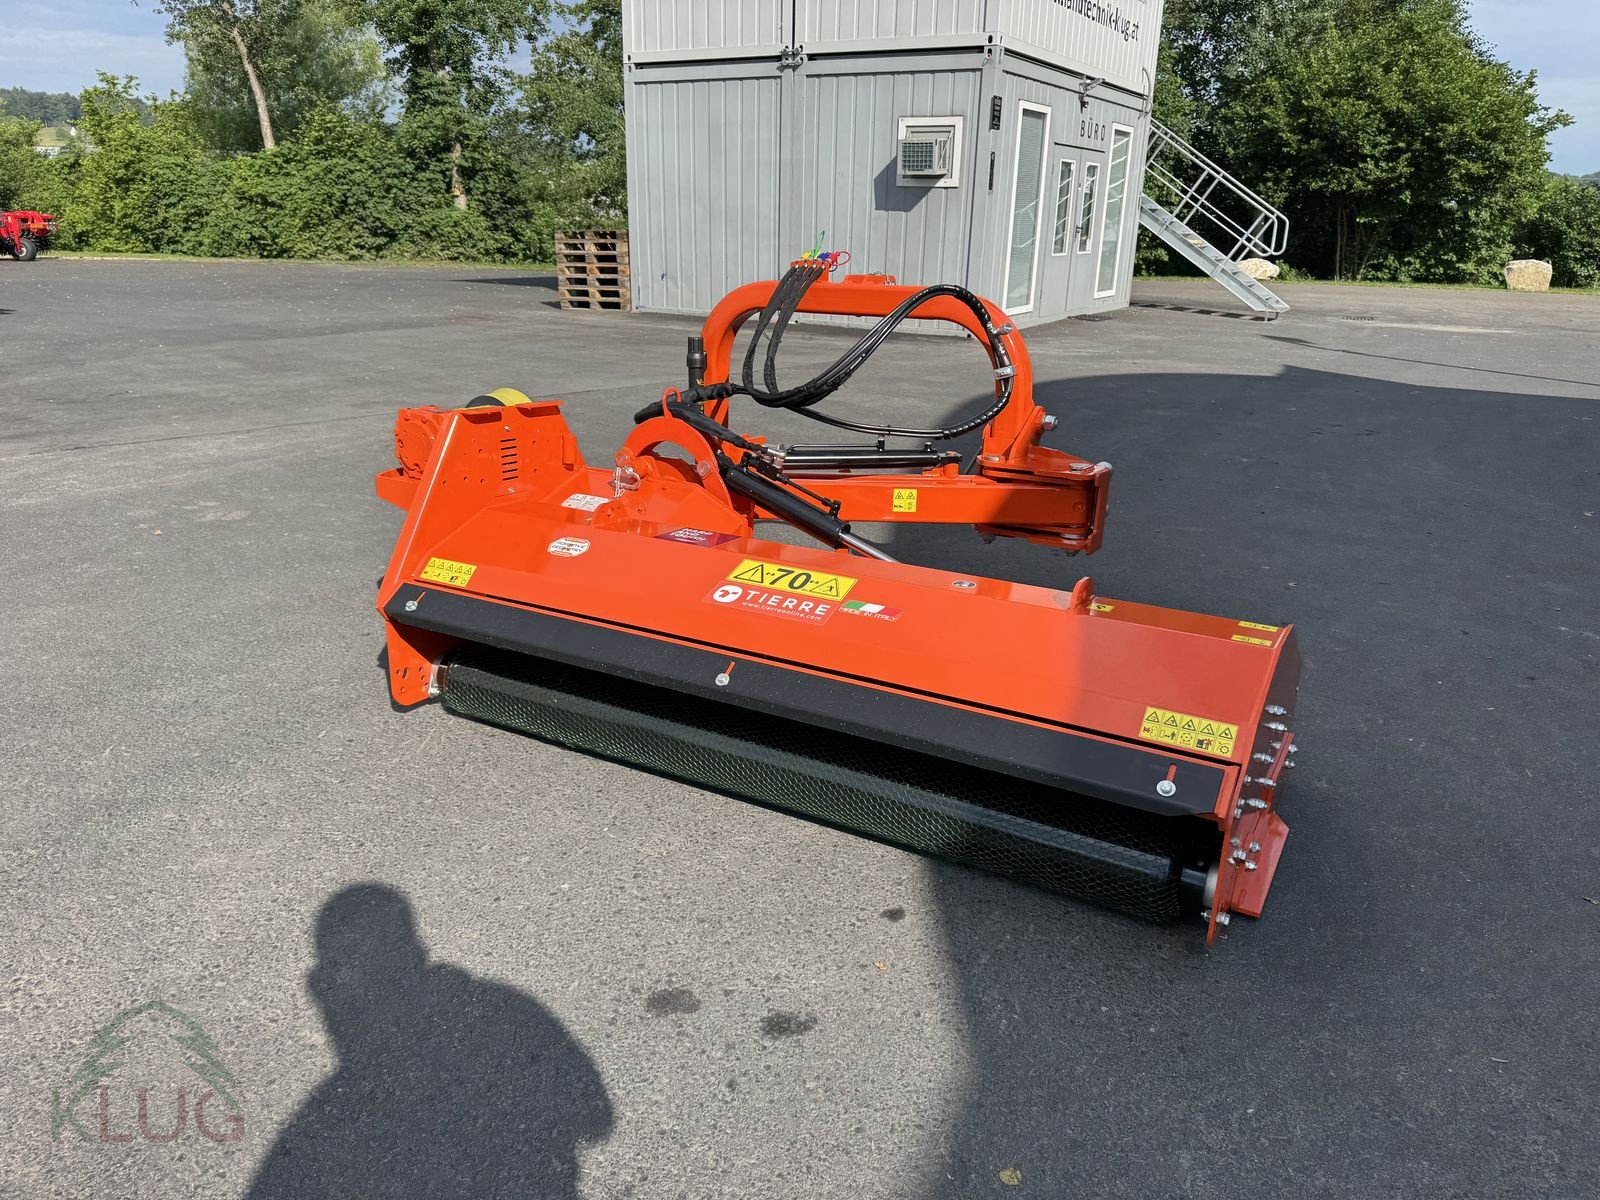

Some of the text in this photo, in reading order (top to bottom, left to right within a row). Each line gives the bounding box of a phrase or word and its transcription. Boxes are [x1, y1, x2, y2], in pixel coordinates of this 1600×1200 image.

[1080, 116, 1106, 141] BÜRO
[768, 567, 813, 590] 70
[742, 601, 822, 621] www.tierreonline.com
[745, 590, 831, 615] TIERRE
[838, 607, 862, 615] MADE
[873, 613, 897, 622] ITALY
